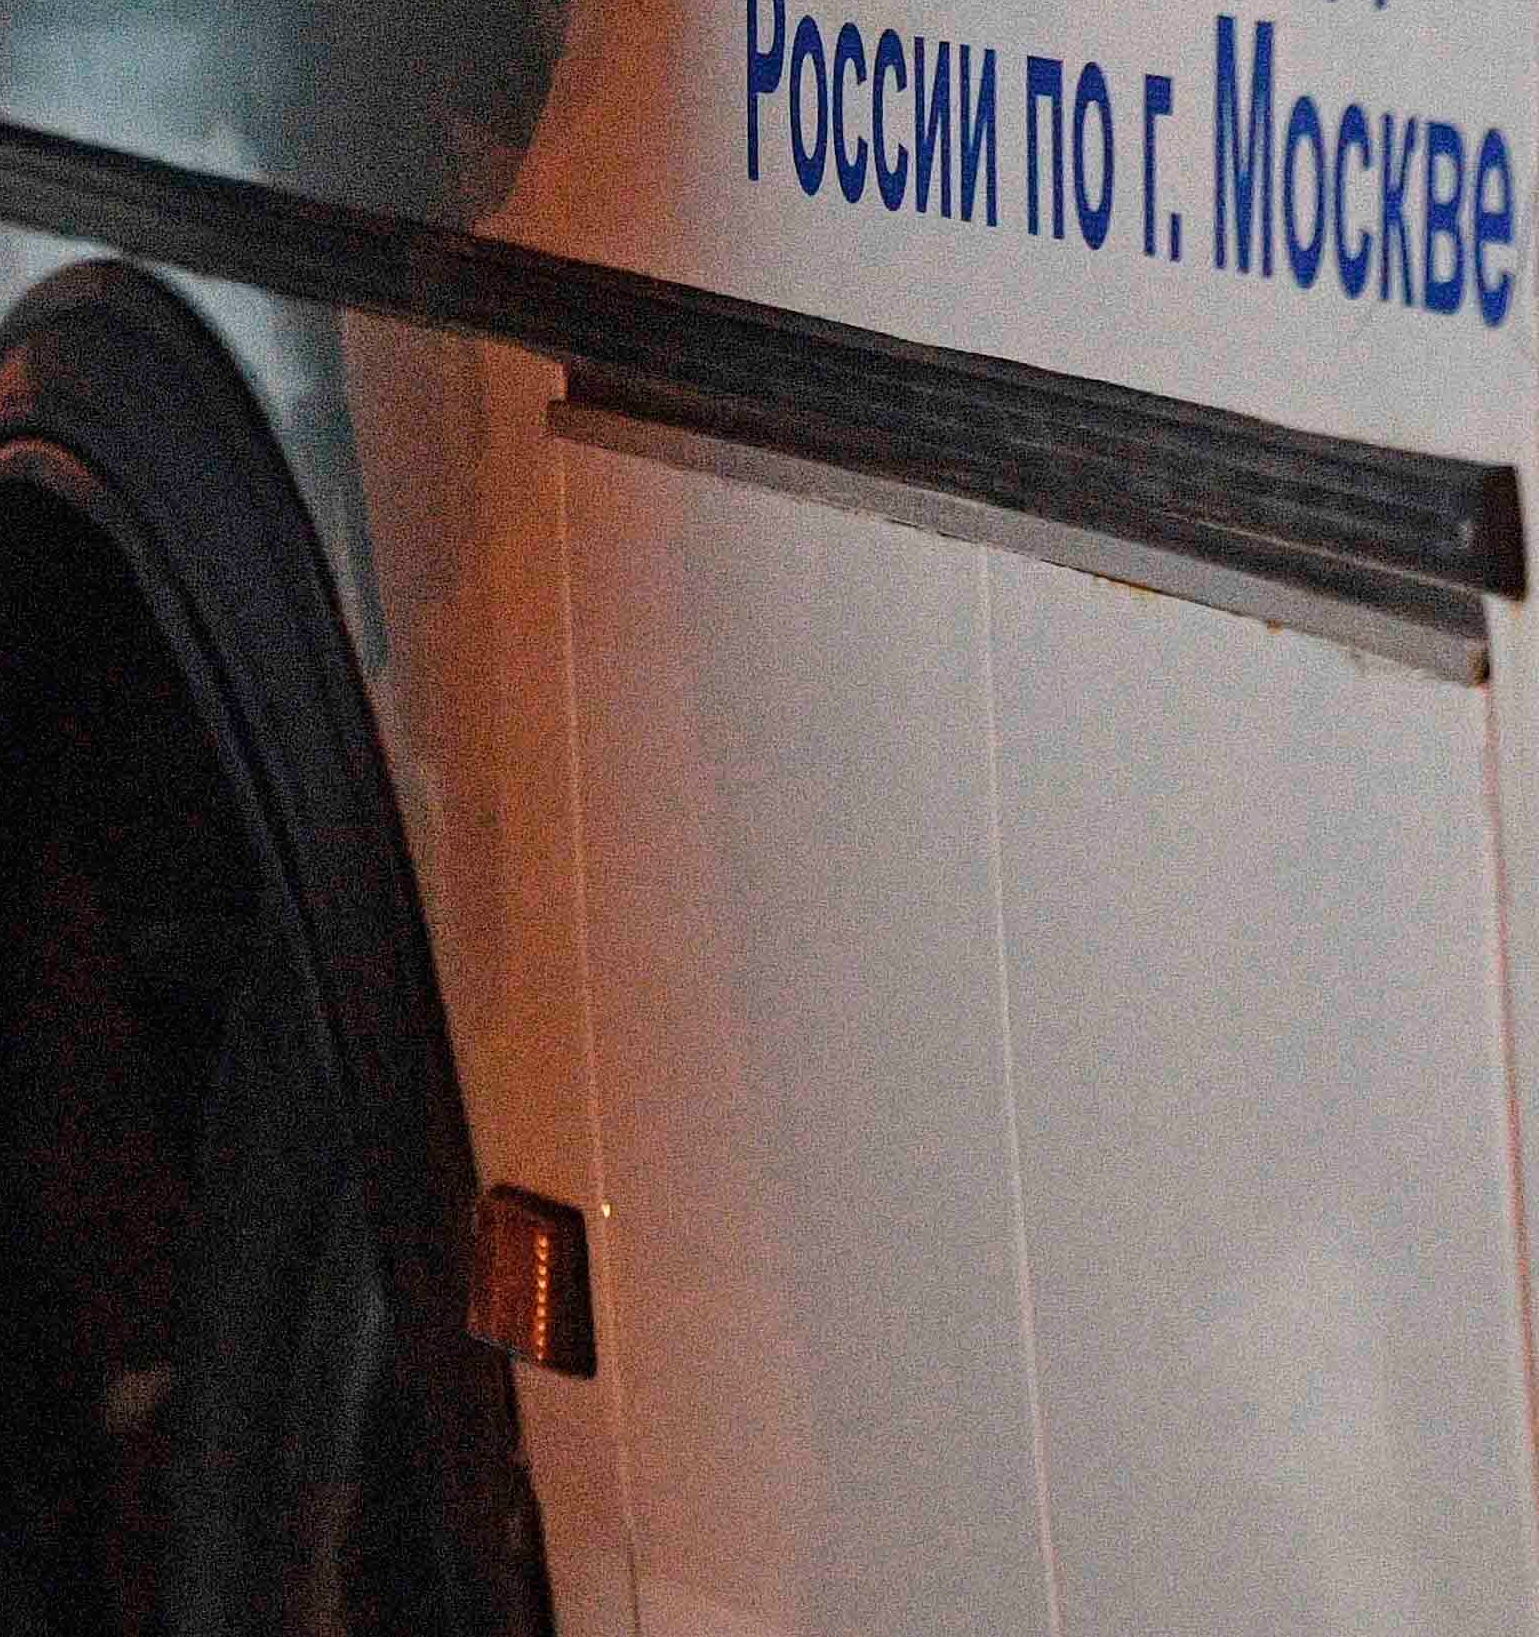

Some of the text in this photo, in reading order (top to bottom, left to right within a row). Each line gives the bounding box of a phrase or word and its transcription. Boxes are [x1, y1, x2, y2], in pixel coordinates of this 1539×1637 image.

[1027, 55, 1115, 250] по
[1142, 74, 1182, 263] г.
[1214, 14, 1517, 328] Москве
